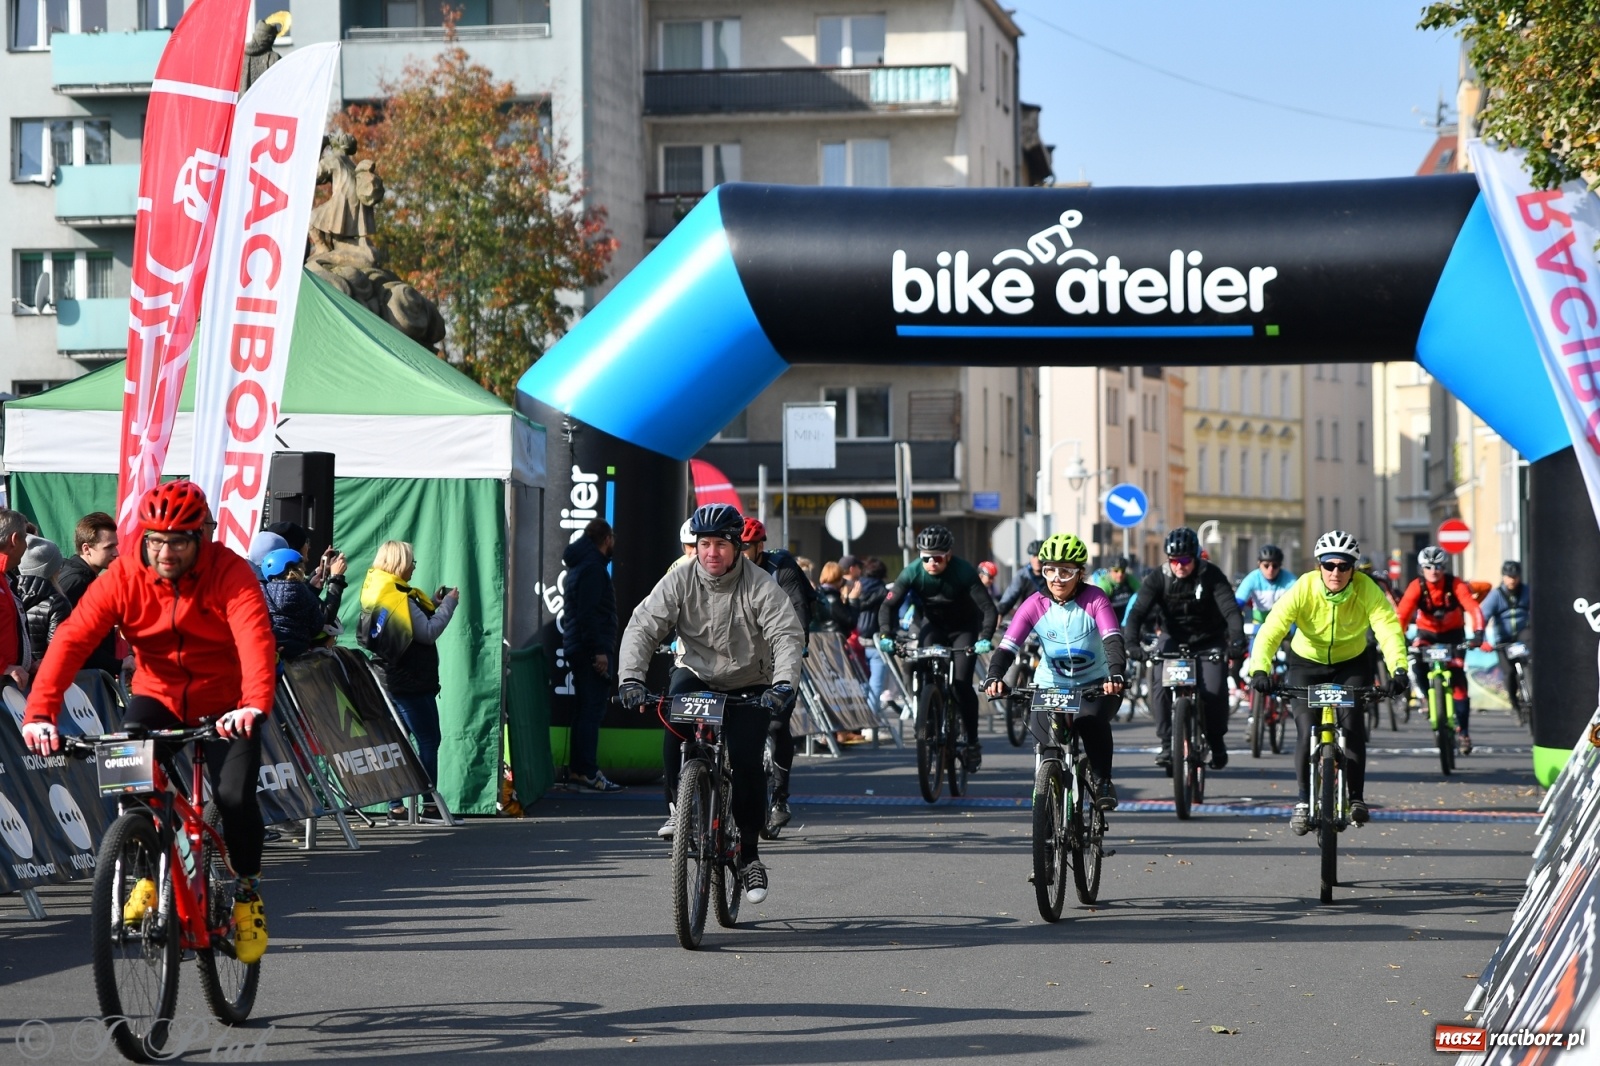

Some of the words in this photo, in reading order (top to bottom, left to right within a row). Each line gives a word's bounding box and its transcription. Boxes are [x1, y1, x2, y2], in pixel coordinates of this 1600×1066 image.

[892, 249, 1035, 315] bike
[1055, 249, 1278, 315] atelier
[217, 112, 299, 554] RACIBÓRZ
[1044, 699, 1068, 707] 152
[1319, 694, 1342, 702] 122
[683, 703, 710, 716] 271
[104, 756, 144, 769] OPIEKUN
[333, 742, 407, 778] MERIDA
